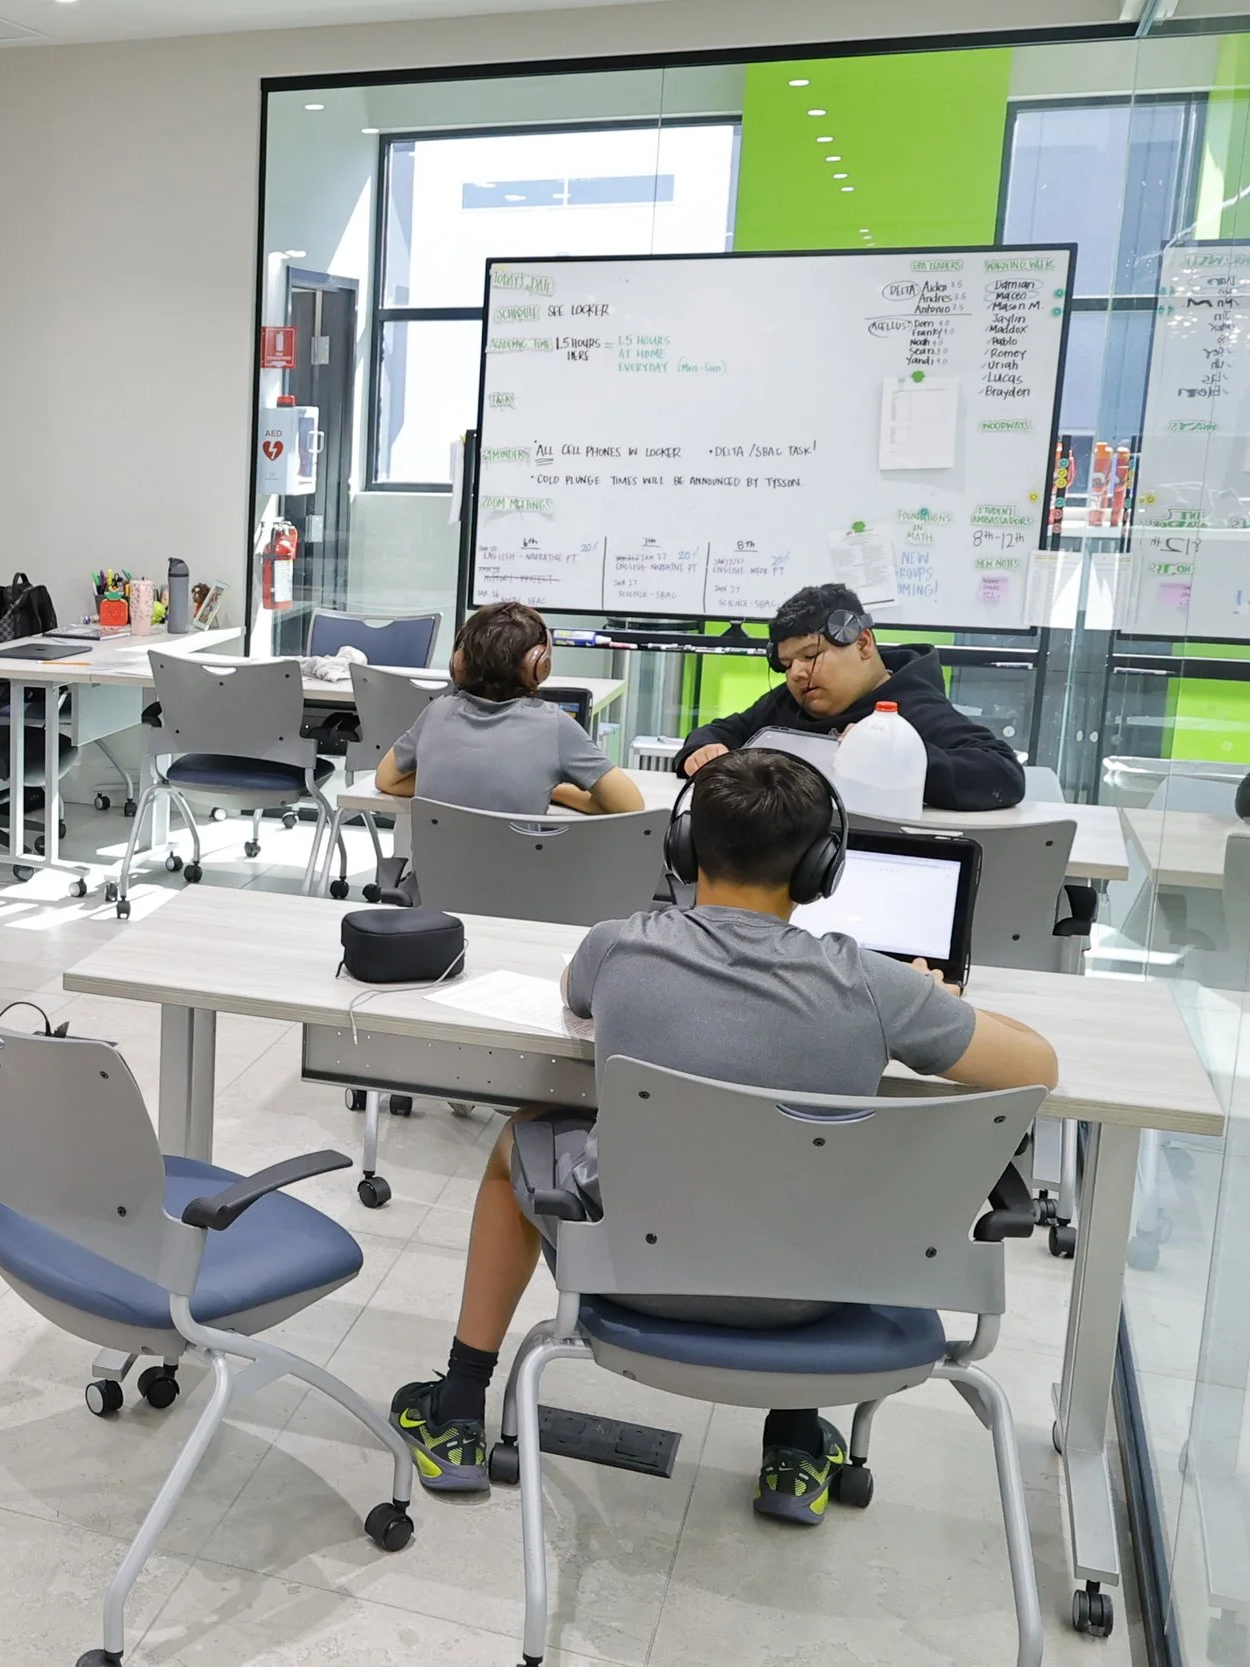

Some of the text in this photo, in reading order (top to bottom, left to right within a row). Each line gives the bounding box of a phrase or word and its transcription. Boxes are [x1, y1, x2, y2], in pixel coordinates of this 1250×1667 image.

[994, 280, 1035, 290] Damian
[889, 285, 916, 297] DELTA
[918, 293, 952, 304] Andres
[548, 304, 564, 316] SEE
[571, 304, 610, 317] LOCKER
[914, 304, 951, 314] Antonio
[992, 301, 1025, 312] Mason
[989, 324, 1028, 334] Maddox
[571, 338, 601, 348] HOURS
[637, 335, 671, 346] HOURS
[992, 336, 1018, 346] Pablo
[618, 349, 665, 359] AT HOME
[618, 362, 668, 373] EVERYDAY
[988, 359, 1019, 370] Uriah
[987, 372, 1023, 384] Lucas
[985, 386, 1031, 400] Brayden
[264, 430, 283, 438] AED
[535, 444, 553, 456] ALL
[561, 444, 582, 456] CELL
[585, 445, 621, 458] PHONES
[645, 446, 681, 459] LOCKER
[715, 446, 744, 457] DELTA
[537, 475, 560, 485] COLD
[565, 475, 601, 486] PLUNGE
[610, 475, 638, 486] TIMES
[642, 475, 664, 485] WILL
[673, 476, 684, 486] BE
[689, 476, 741, 487] ANNOUNCED
[746, 477, 759, 489] BY
[736, 540, 756, 550] 8th
[483, 551, 515, 561] ENGLISH
[901, 551, 929, 564] NEW
